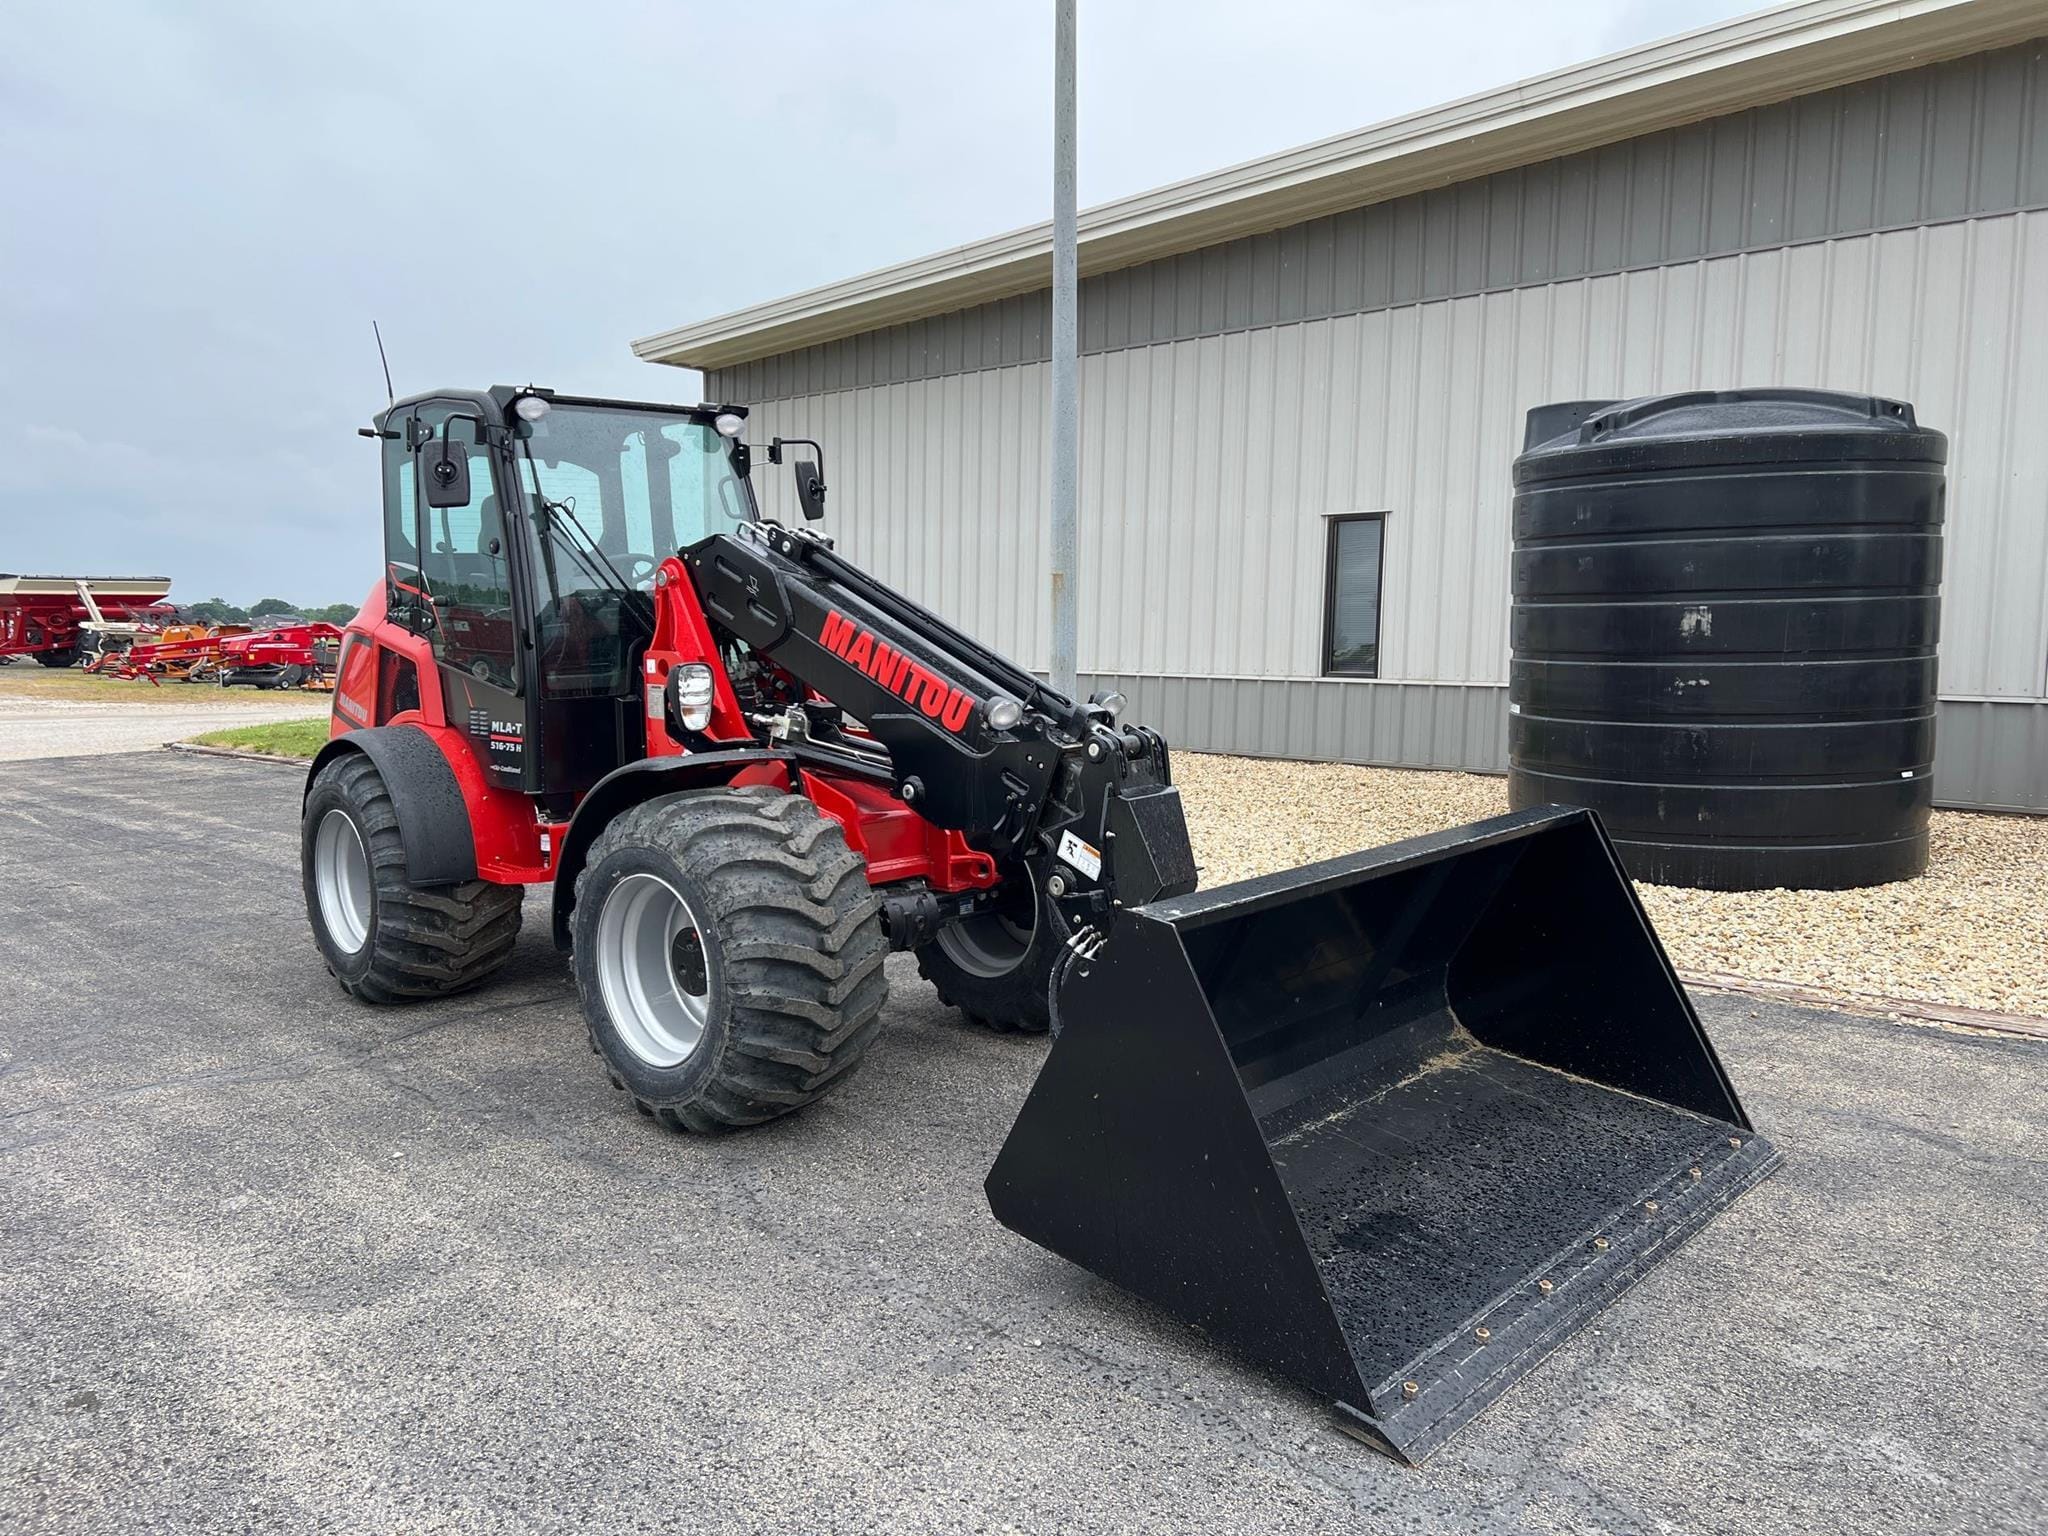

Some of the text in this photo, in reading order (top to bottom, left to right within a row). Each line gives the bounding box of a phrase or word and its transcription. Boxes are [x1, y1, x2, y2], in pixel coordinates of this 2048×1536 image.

[818, 608, 976, 733] MANITOU
[339, 691, 368, 723] MANITOU
[515, 743, 522, 753] H
